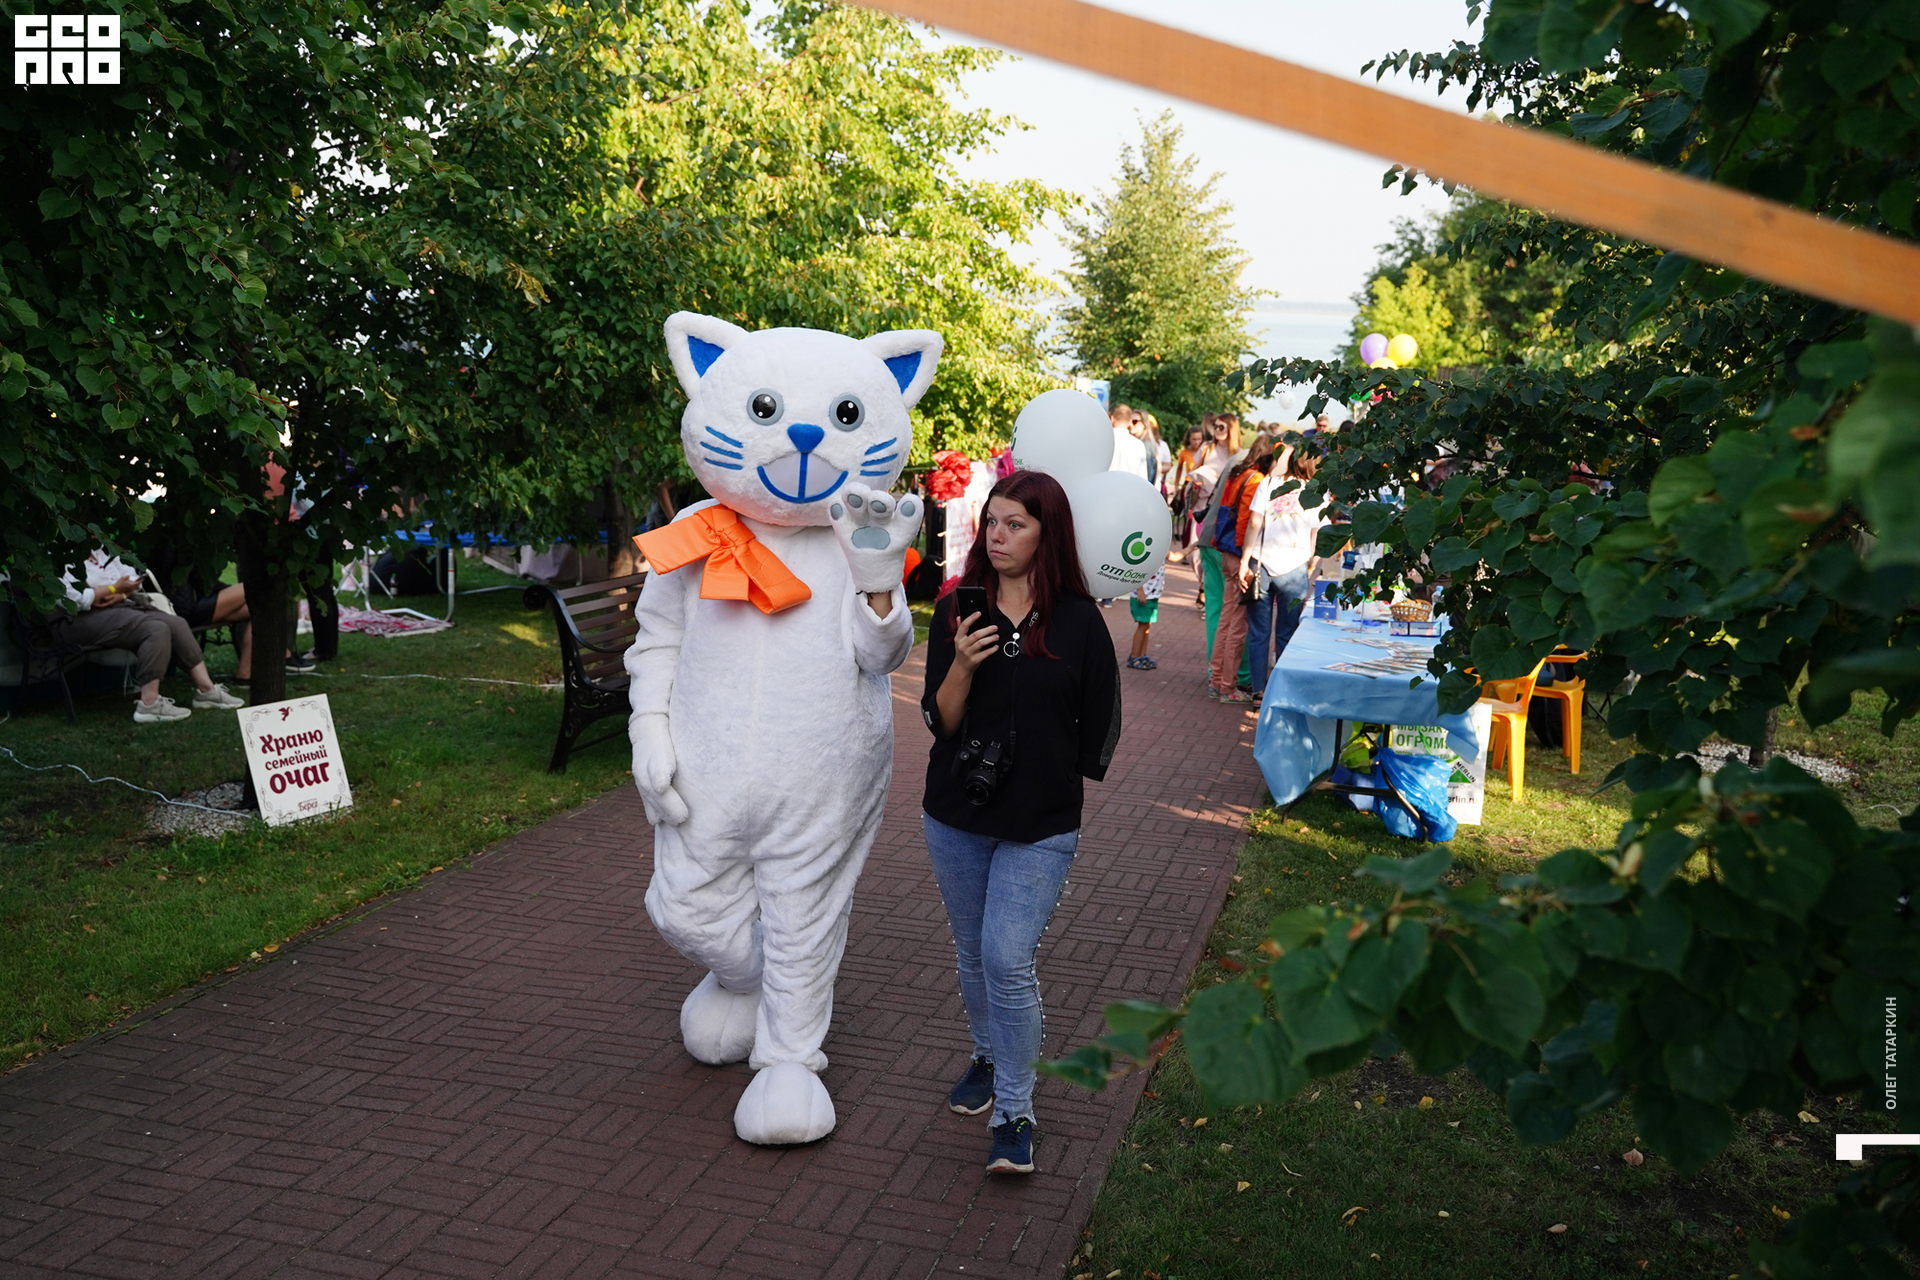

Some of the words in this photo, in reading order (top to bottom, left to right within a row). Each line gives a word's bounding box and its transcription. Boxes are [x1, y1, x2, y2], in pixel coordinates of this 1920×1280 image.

[259, 729, 323, 756] Храню
[1396, 734, 1449, 750] ОГРОМ
[265, 745, 328, 771] семейный
[1456, 761, 1476, 783] MERLIN
[1448, 796, 1477, 804] erlin.ru
